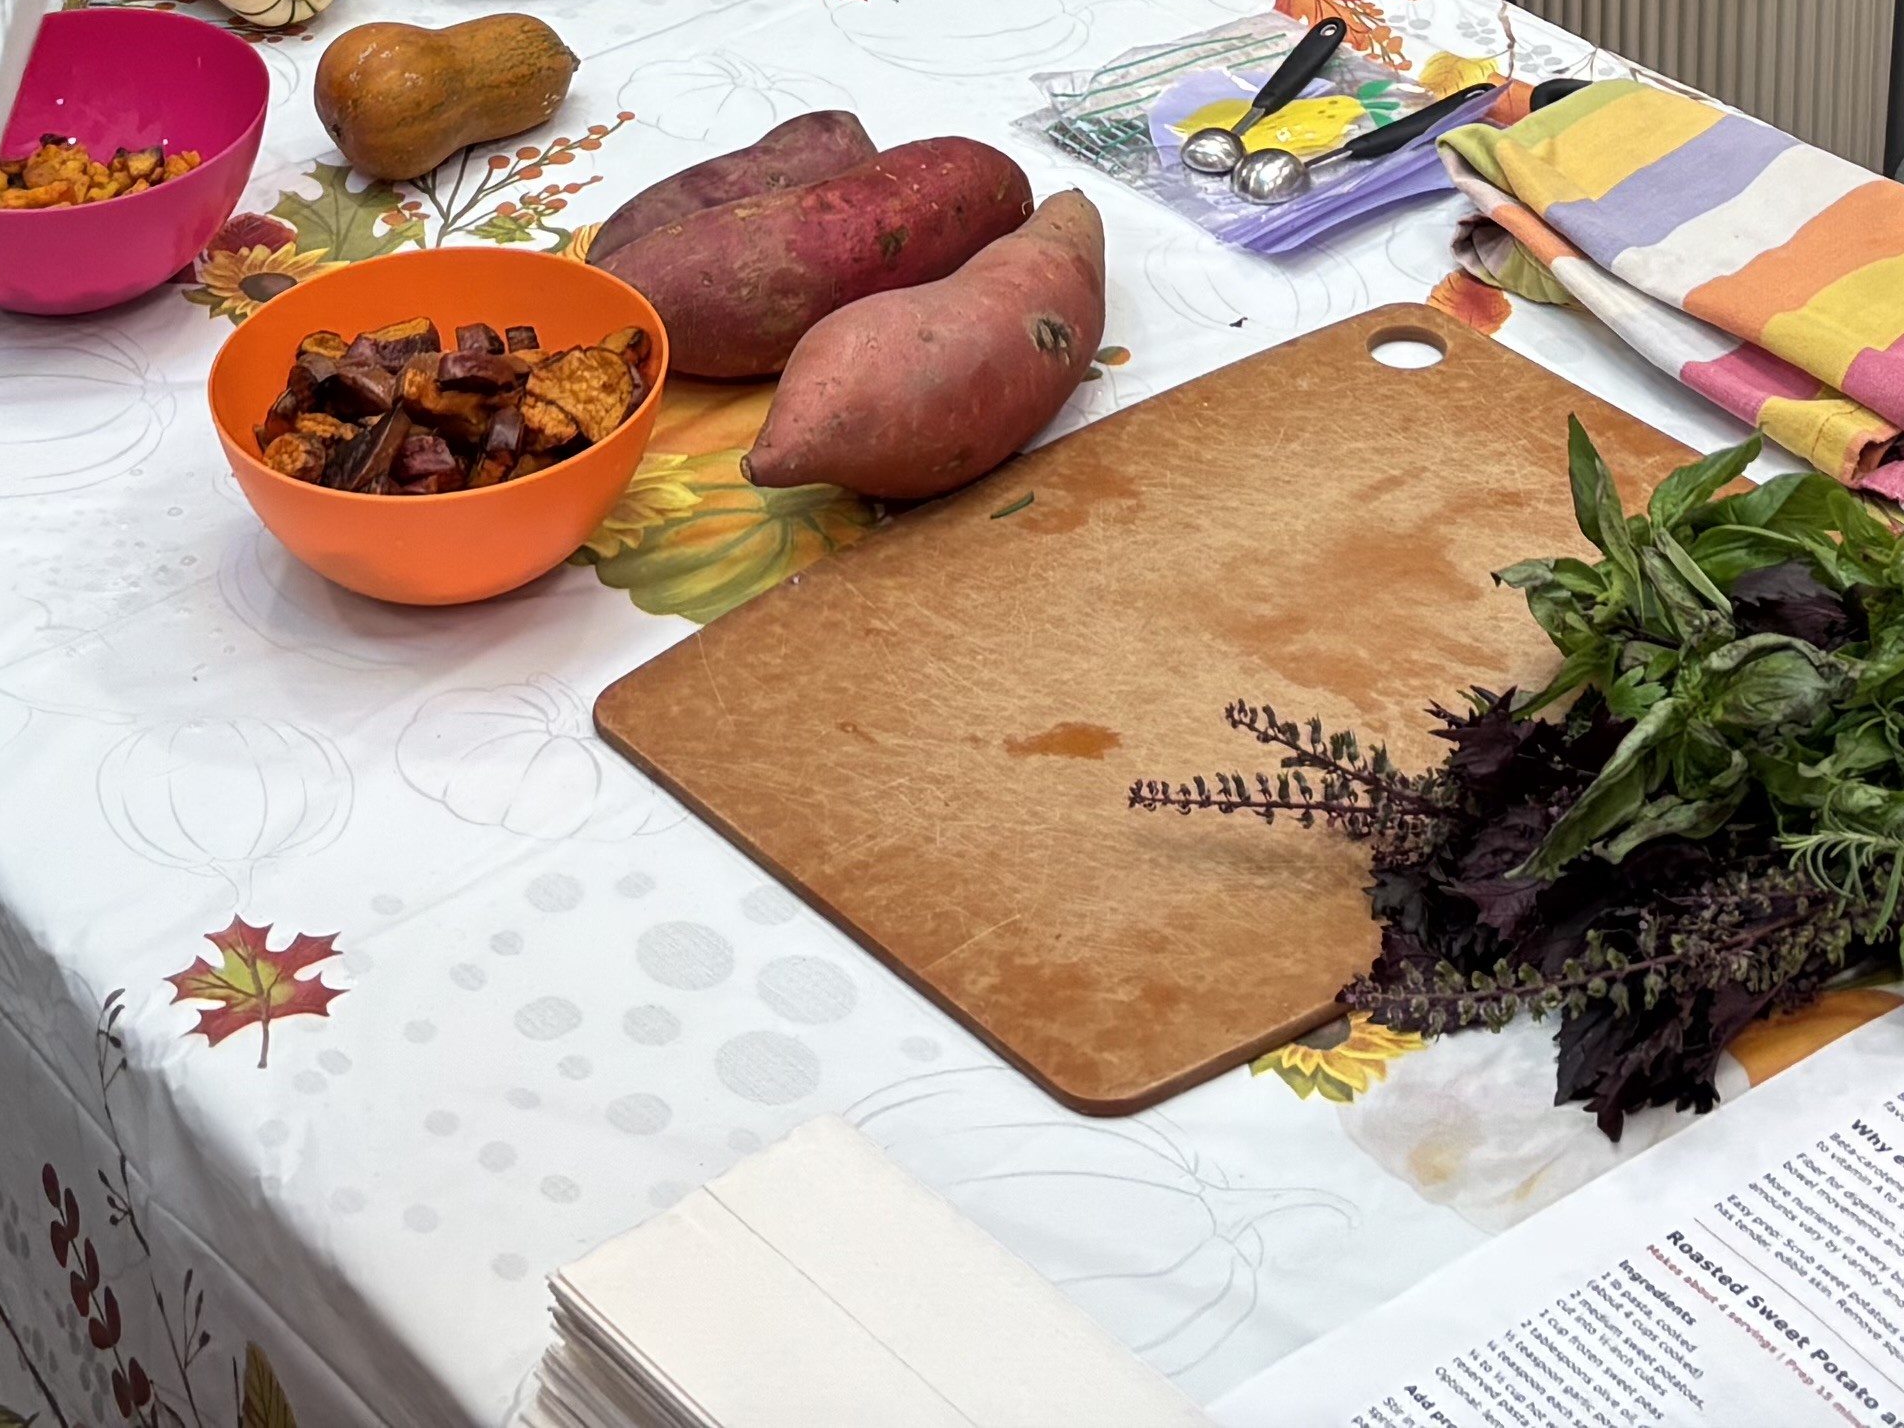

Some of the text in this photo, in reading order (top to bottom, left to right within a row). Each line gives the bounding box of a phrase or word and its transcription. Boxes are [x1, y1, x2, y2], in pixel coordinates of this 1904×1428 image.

[1851, 1119, 1892, 1152] Why
[1782, 1160, 1819, 1189] bowel
[1816, 1188, 1883, 1239] movements
[1796, 1152, 1826, 1176] Fiber
[1825, 1176, 1844, 1190] for
[1815, 1141, 1829, 1152] to
[1830, 1152, 1872, 1185] vitamin
[1872, 1185, 1883, 1194] A
[1883, 1192, 1897, 1203] to
[1618, 1259, 1696, 1326] Ingredients
[1666, 1230, 1878, 1409] Roasted Sweet Potato
[1404, 1385, 1435, 1410] Add
